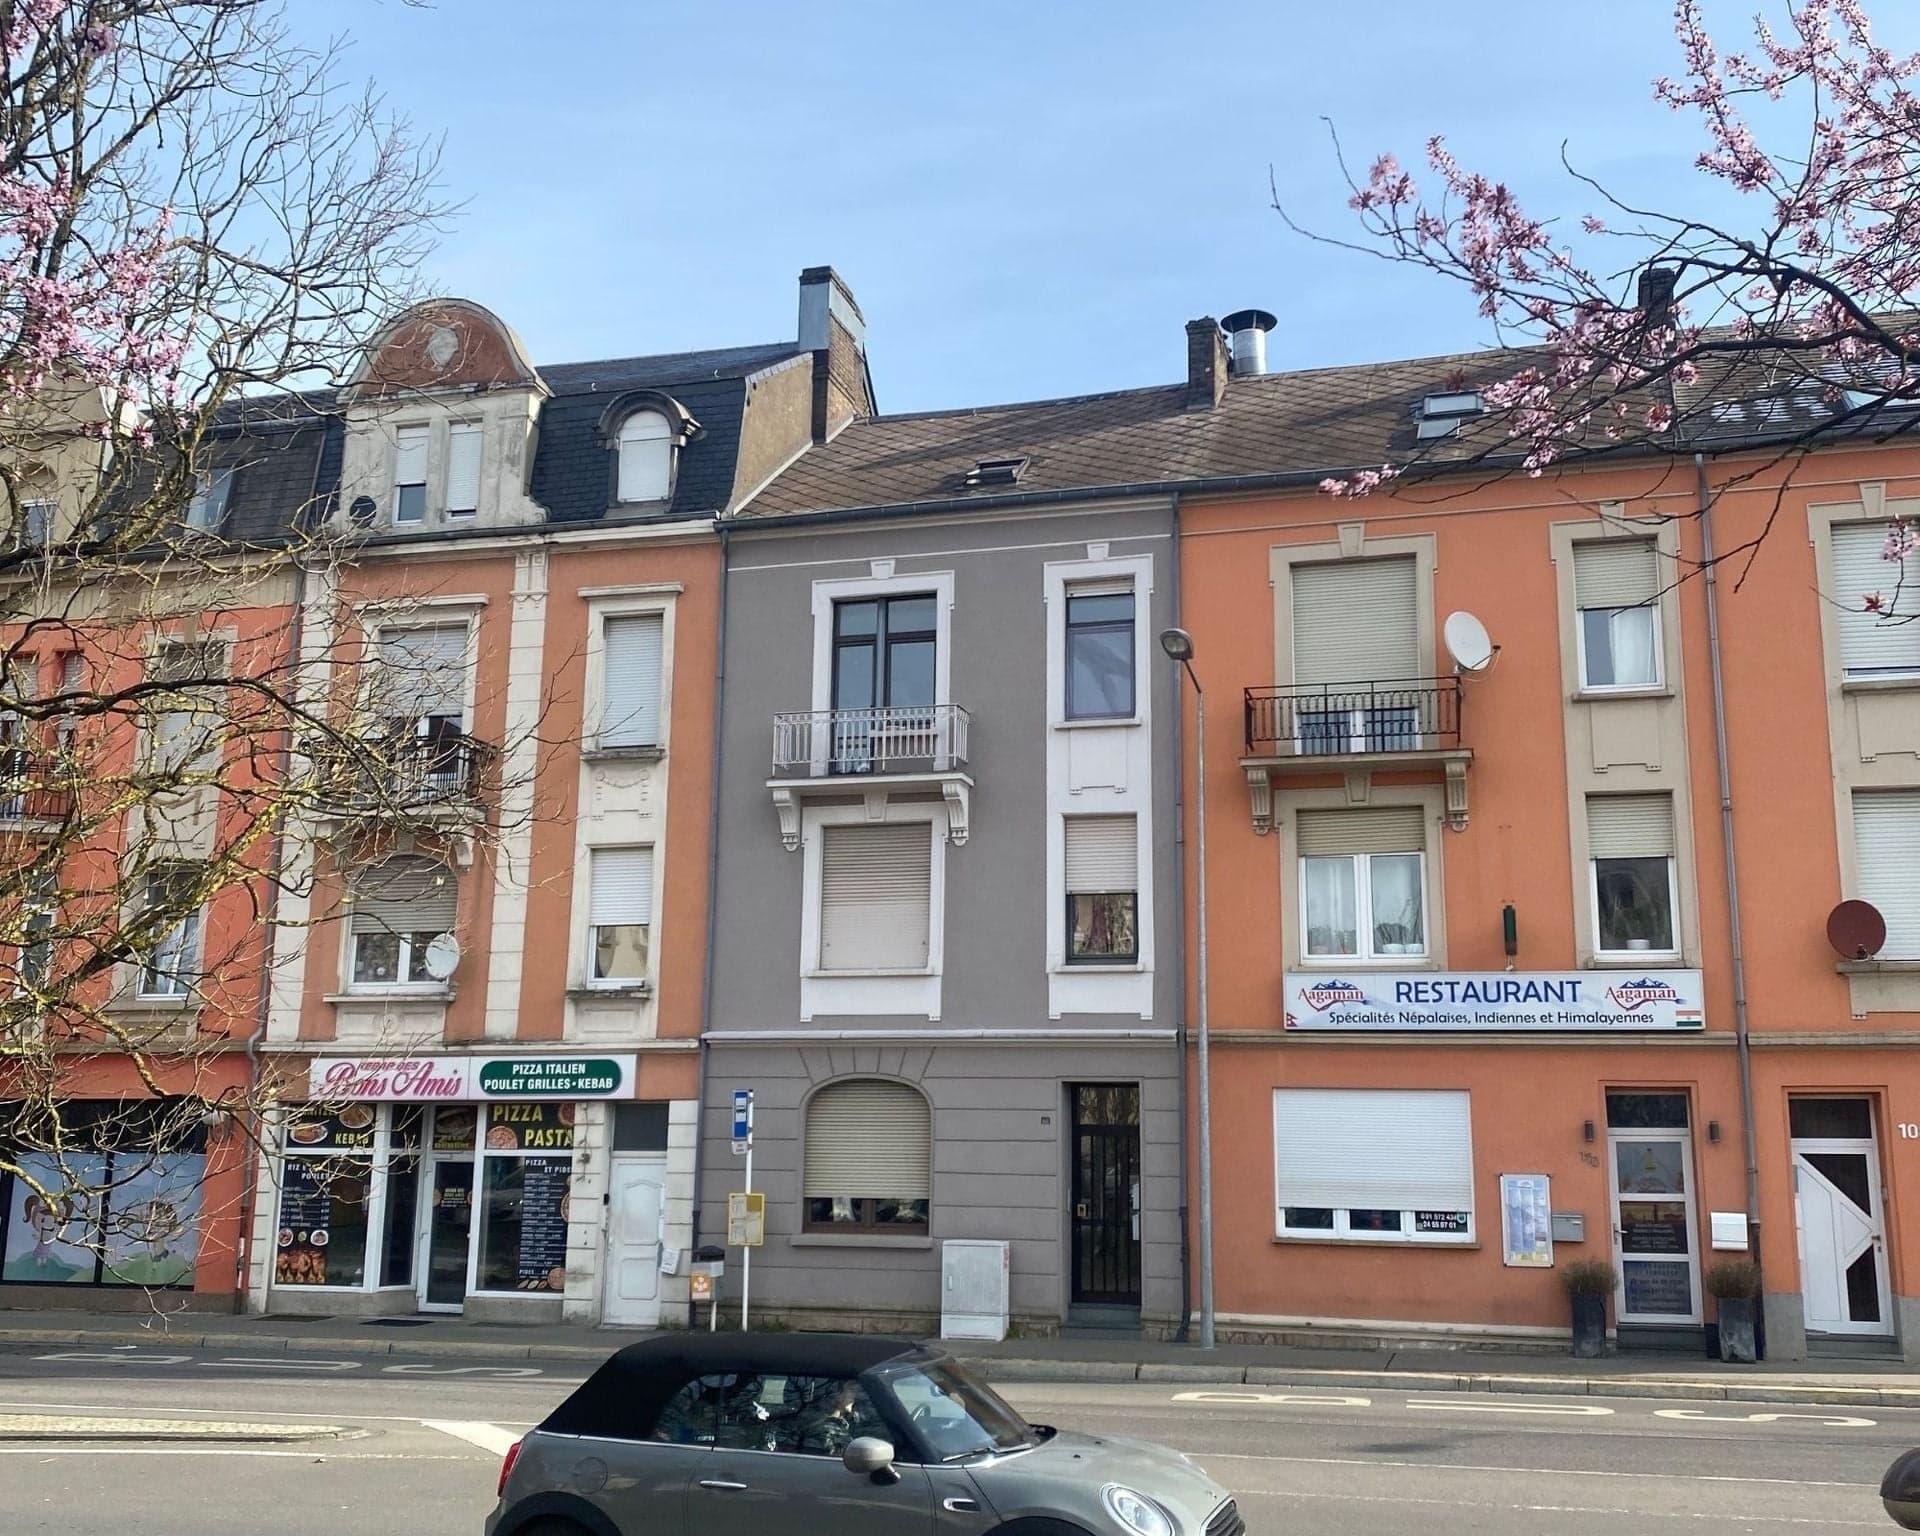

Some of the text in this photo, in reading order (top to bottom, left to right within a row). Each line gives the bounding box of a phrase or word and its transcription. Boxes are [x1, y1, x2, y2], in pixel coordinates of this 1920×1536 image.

[1298, 987, 1364, 1005] Aagaman
[1395, 980, 1582, 1003] RESTAURANT
[1605, 986, 1677, 1005] Aagaman
[1329, 1011, 1654, 1025] Spécialités Népalaises, Indiennes et Himalayennes
[512, 1063, 586, 1075] PIZZA ITALIEN
[391, 1061, 462, 1097] Amis
[484, 1078, 613, 1090] POULET GRILLES KEBAB
[492, 1104, 543, 1121] PIZZA
[524, 1129, 574, 1147] PASTA
